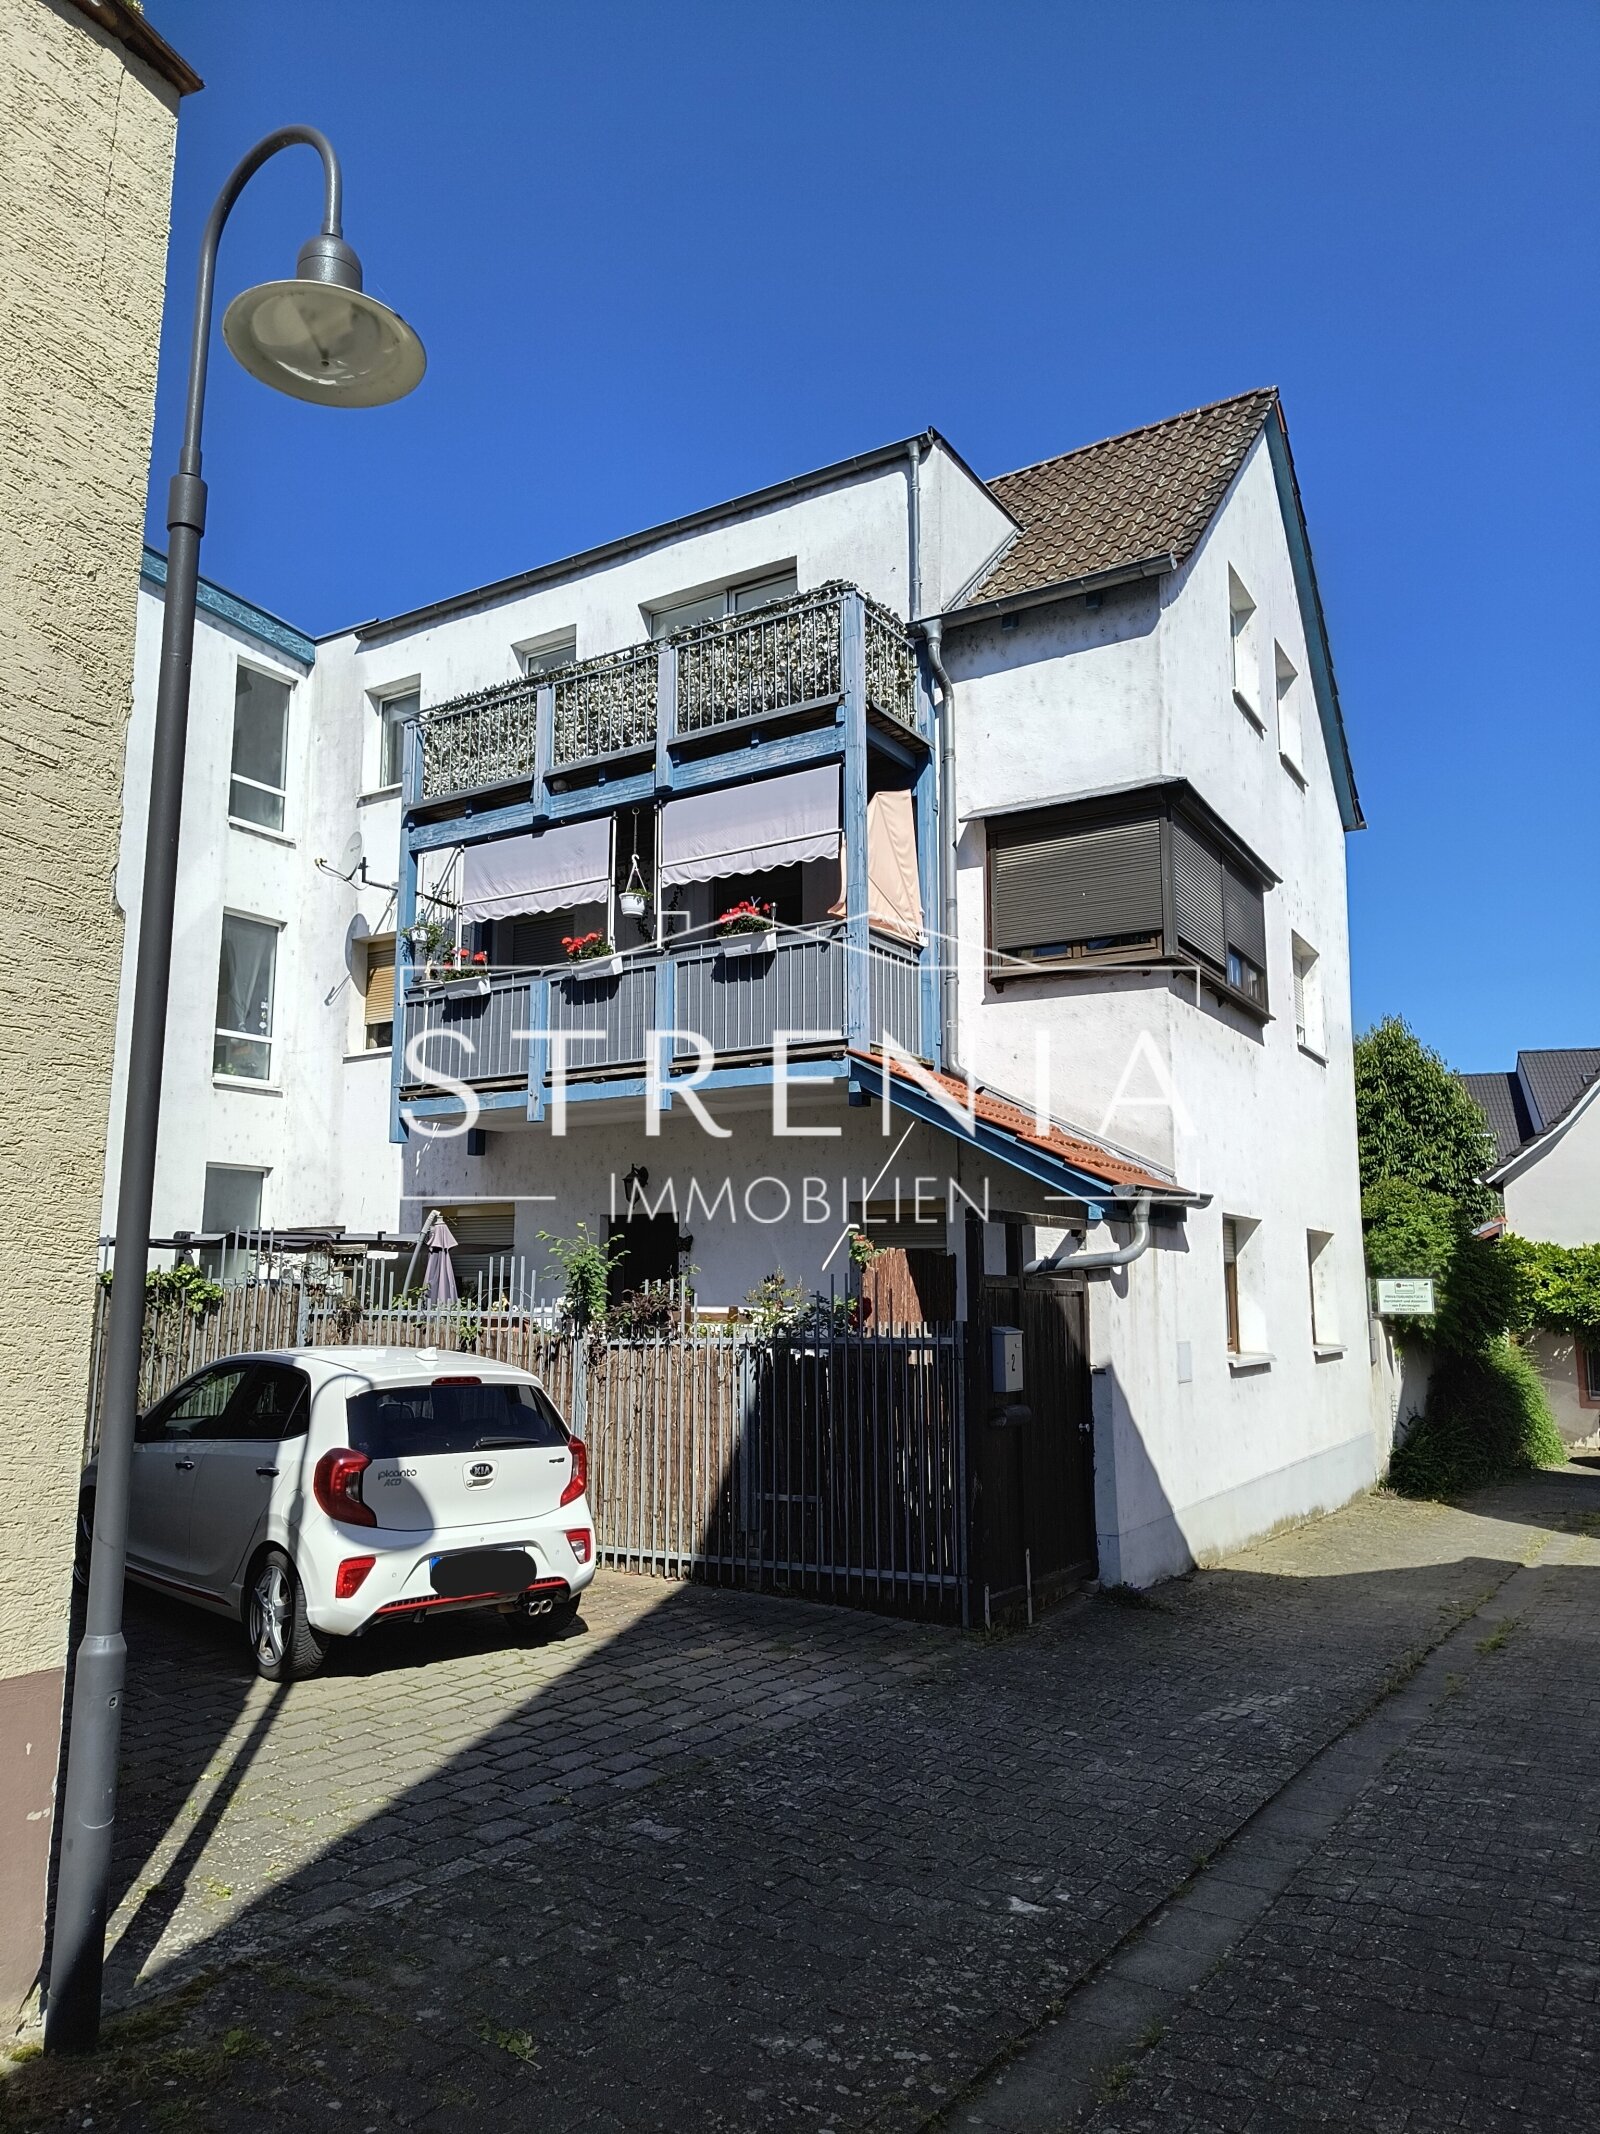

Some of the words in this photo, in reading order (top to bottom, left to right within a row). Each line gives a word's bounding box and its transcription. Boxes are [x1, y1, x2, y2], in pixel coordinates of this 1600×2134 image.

[1011, 1353, 1016, 1372] 2
[377, 1468, 417, 1480] picanto
[474, 1465, 490, 1475] KIA
